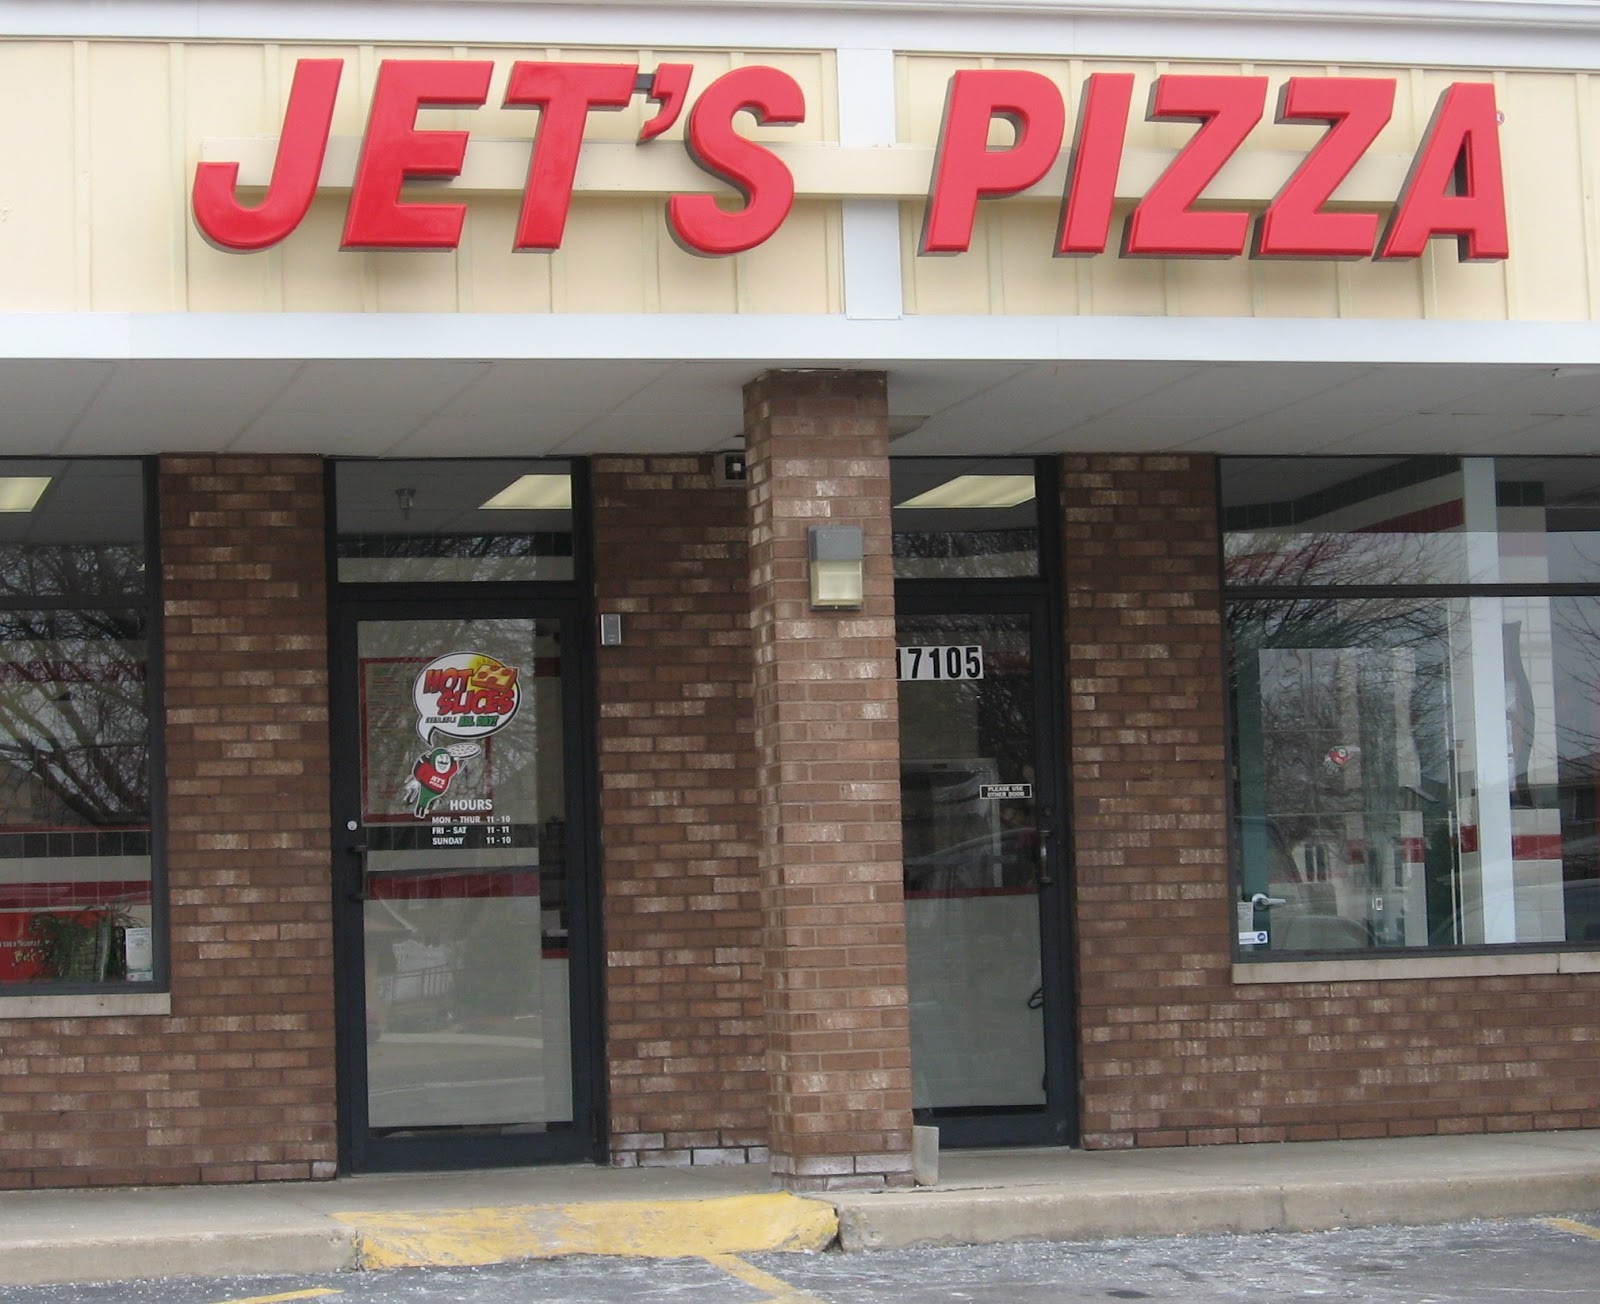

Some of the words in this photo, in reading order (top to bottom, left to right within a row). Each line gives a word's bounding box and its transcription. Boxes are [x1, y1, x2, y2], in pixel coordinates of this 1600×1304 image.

[191, 58, 805, 257] JET'S
[917, 69, 1509, 262] PIZZA
[423, 667, 474, 694] HOT
[436, 689, 515, 715] SLICES
[425, 716, 457, 724] AVAILABLE
[457, 715, 475, 727] ALL
[449, 799, 493, 811] HOURS
[431, 816, 451, 824] MON
[460, 816, 481, 824] THUR
[486, 815, 494, 823] 11
[501, 815, 511, 823] 10
[432, 826, 445, 835] FRI
[453, 826, 467, 834] SAT
[486, 826, 495, 834] 11
[501, 825, 510, 834] 11
[432, 837, 464, 846] SUNDAY
[486, 836, 495, 844] 11
[501, 836, 511, 844] 10
